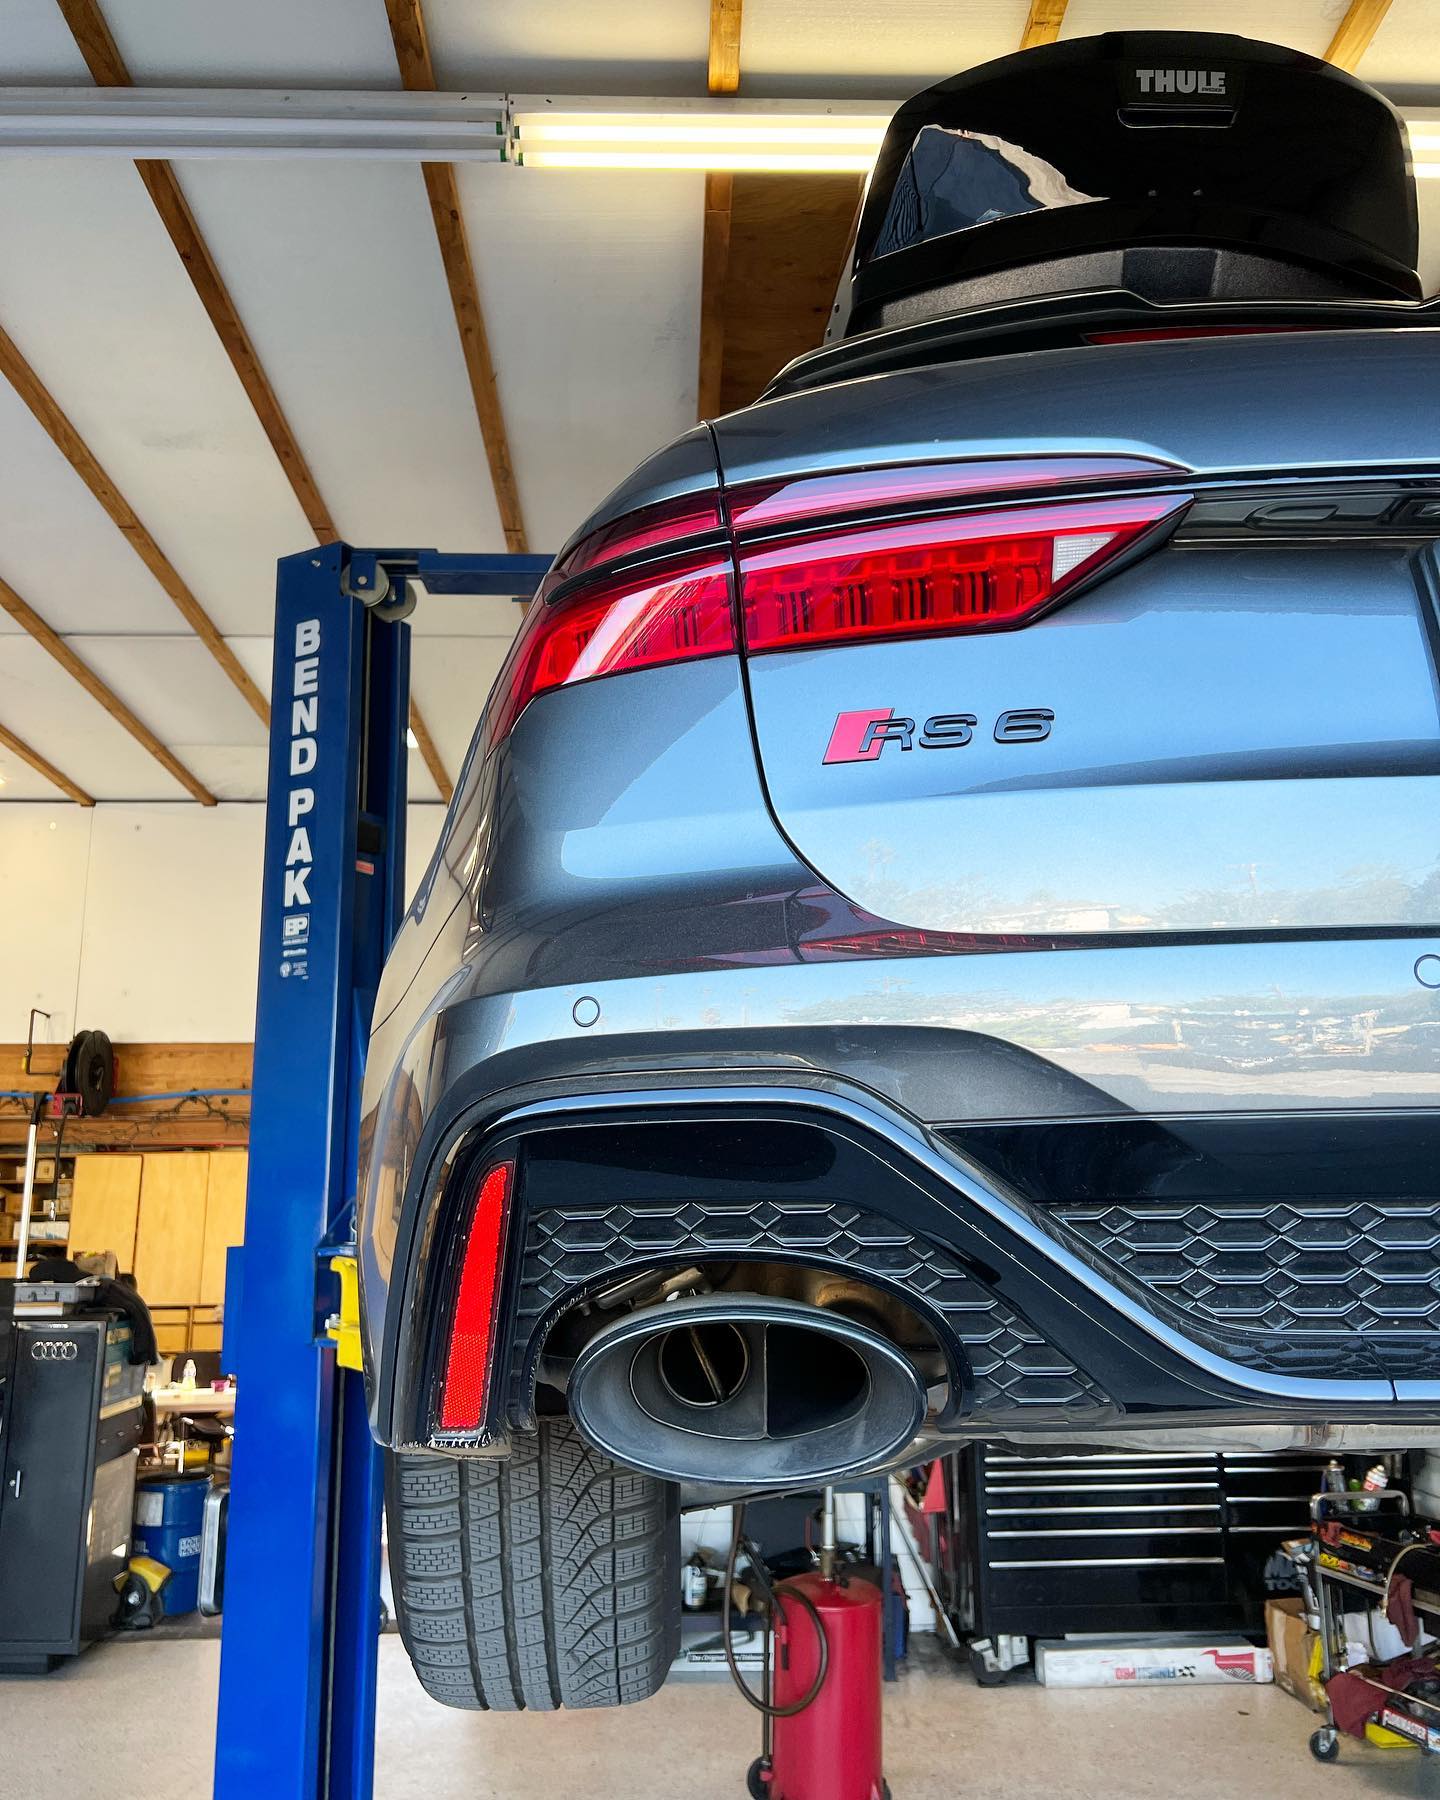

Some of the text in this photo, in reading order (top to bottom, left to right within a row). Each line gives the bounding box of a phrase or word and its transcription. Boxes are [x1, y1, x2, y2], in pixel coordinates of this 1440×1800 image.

[1136, 70, 1226, 94] THULE
[858, 708, 1055, 752] RS 6
[285, 916, 308, 937] BP
